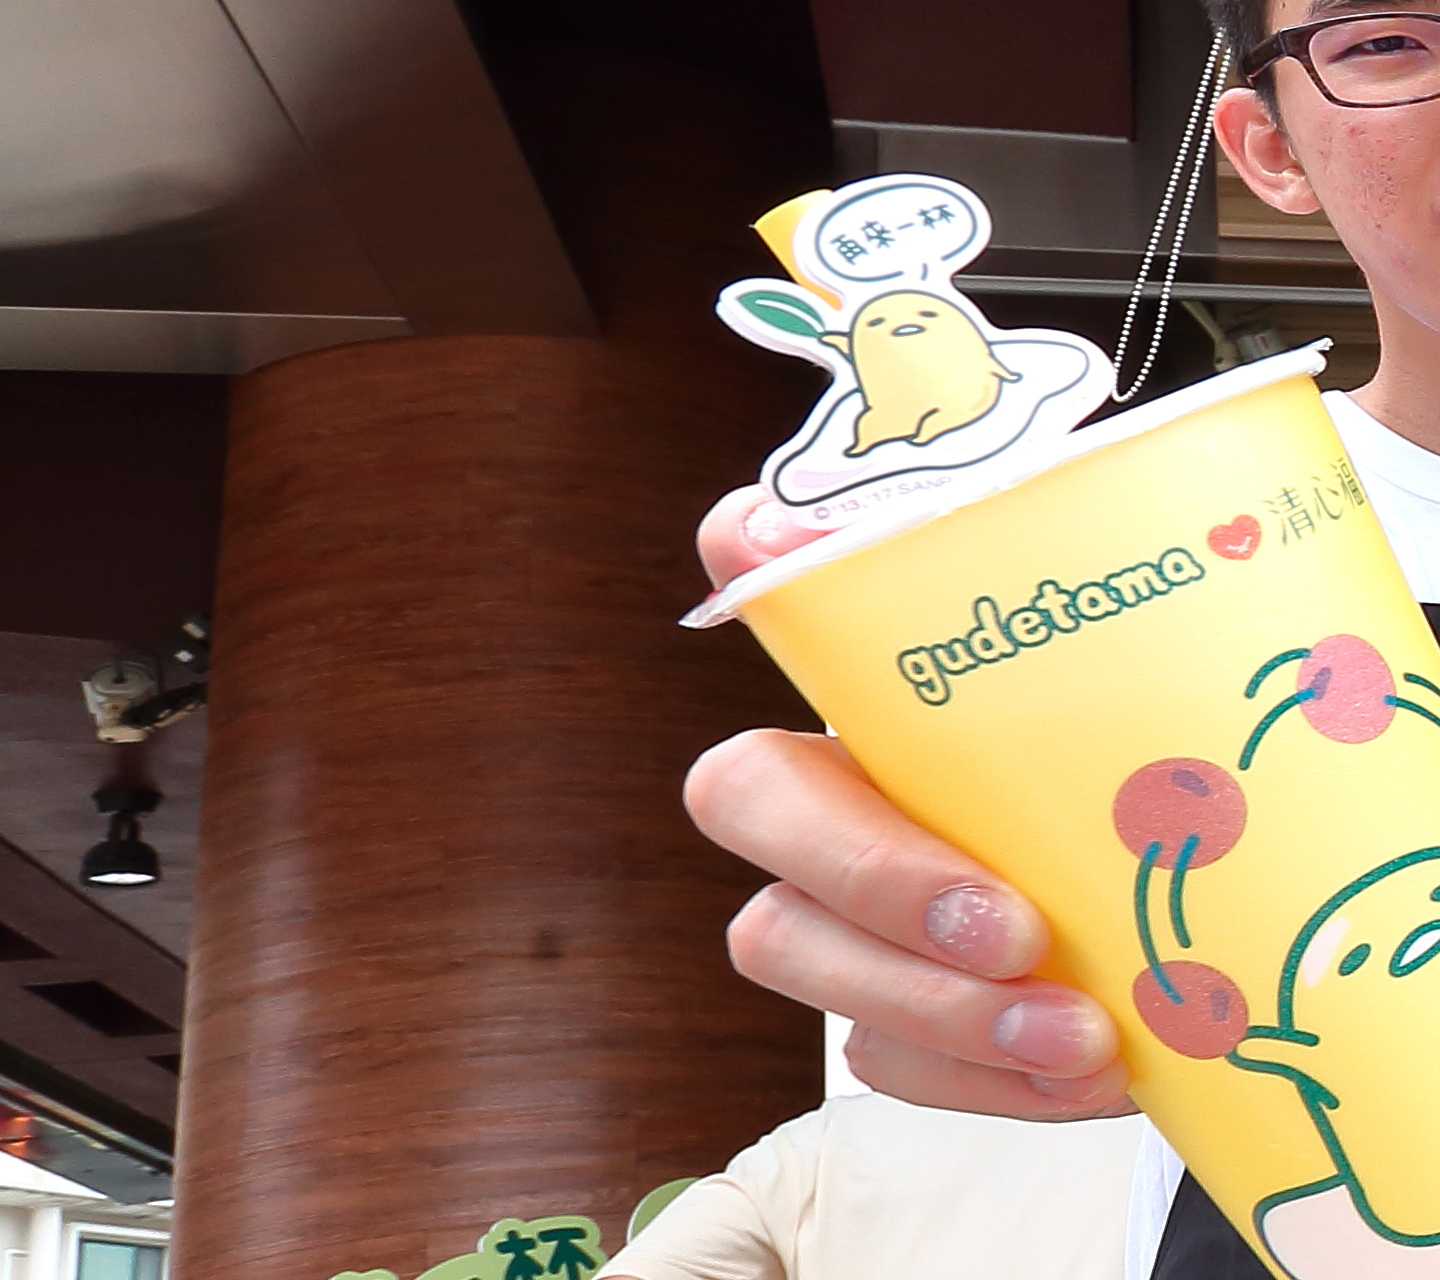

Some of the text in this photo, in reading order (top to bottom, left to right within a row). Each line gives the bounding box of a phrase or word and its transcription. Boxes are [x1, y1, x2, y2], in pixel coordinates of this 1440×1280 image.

[829, 203, 956, 265] 再來一杯
[899, 547, 1205, 705] gudetama
